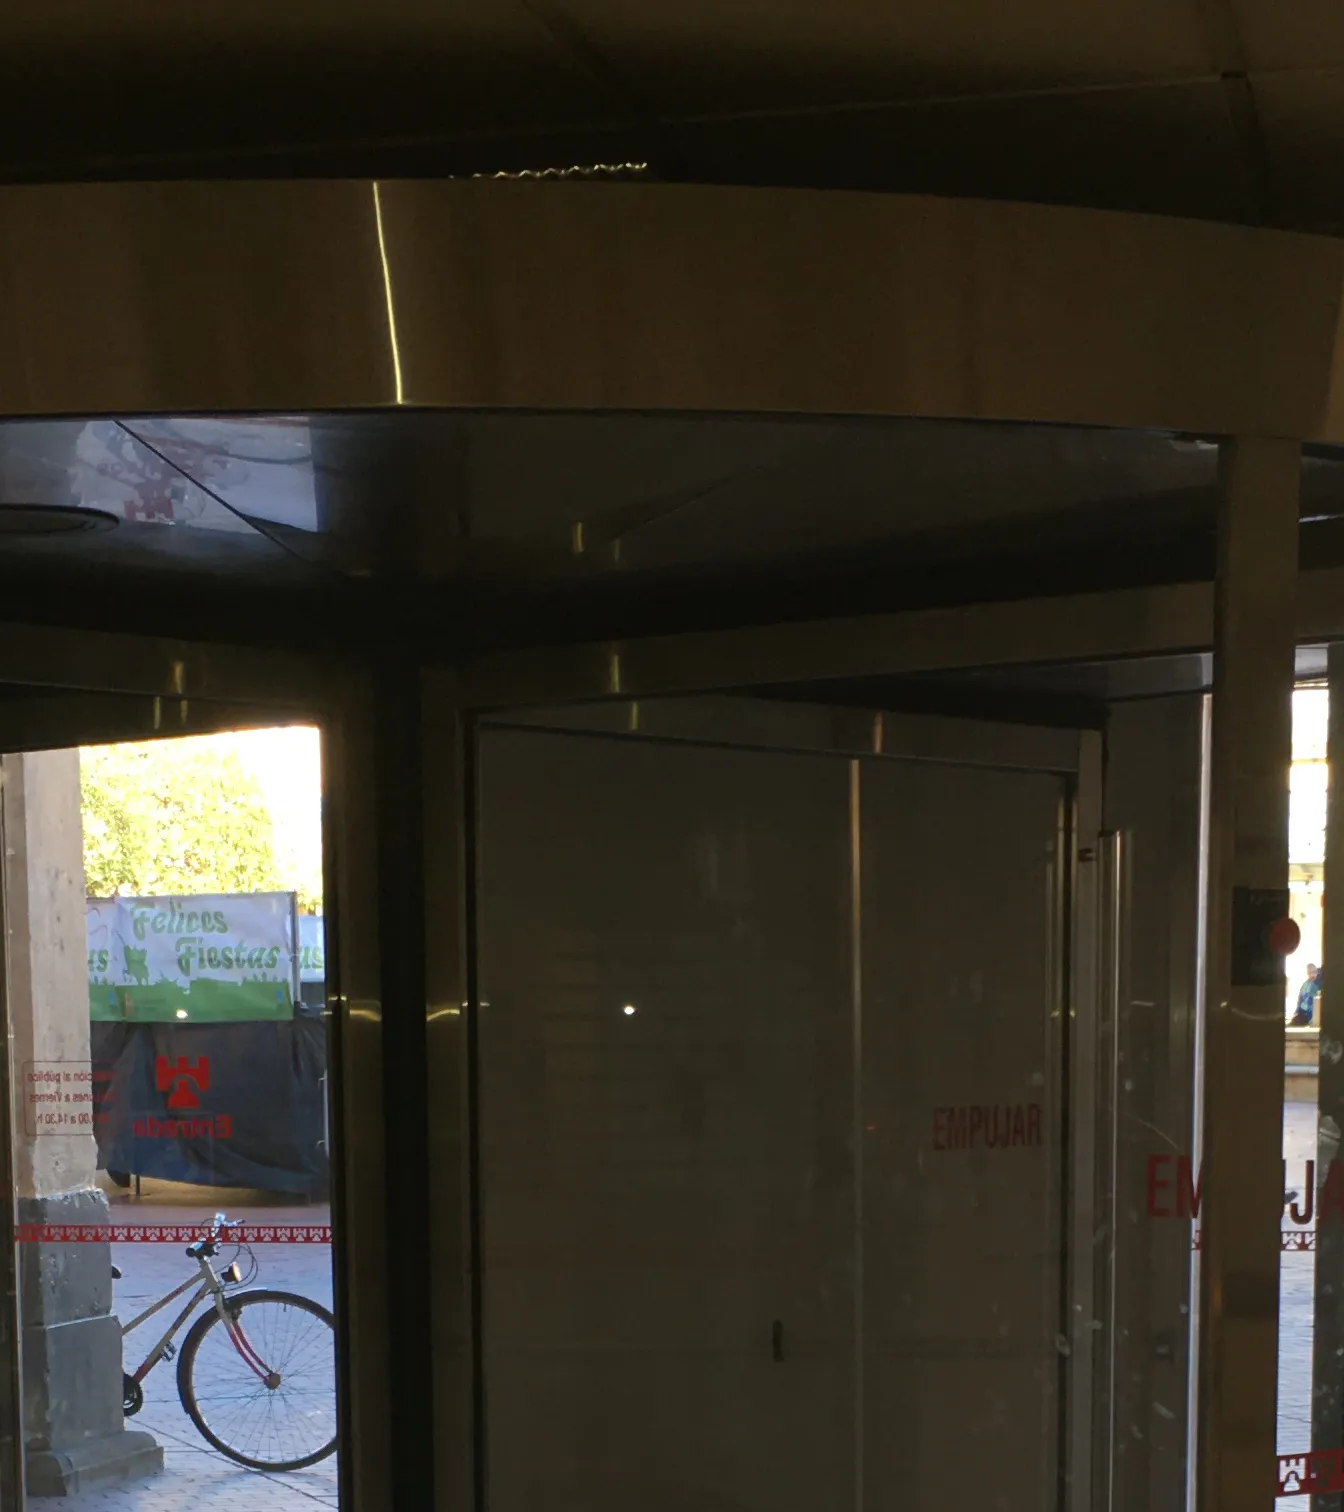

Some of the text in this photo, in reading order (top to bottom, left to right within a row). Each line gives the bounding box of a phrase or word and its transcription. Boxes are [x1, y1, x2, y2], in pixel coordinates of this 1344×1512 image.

[130, 899, 229, 940] Felices
[175, 937, 281, 977] Fiestas
[932, 1103, 1043, 1150] EMPUJAR
